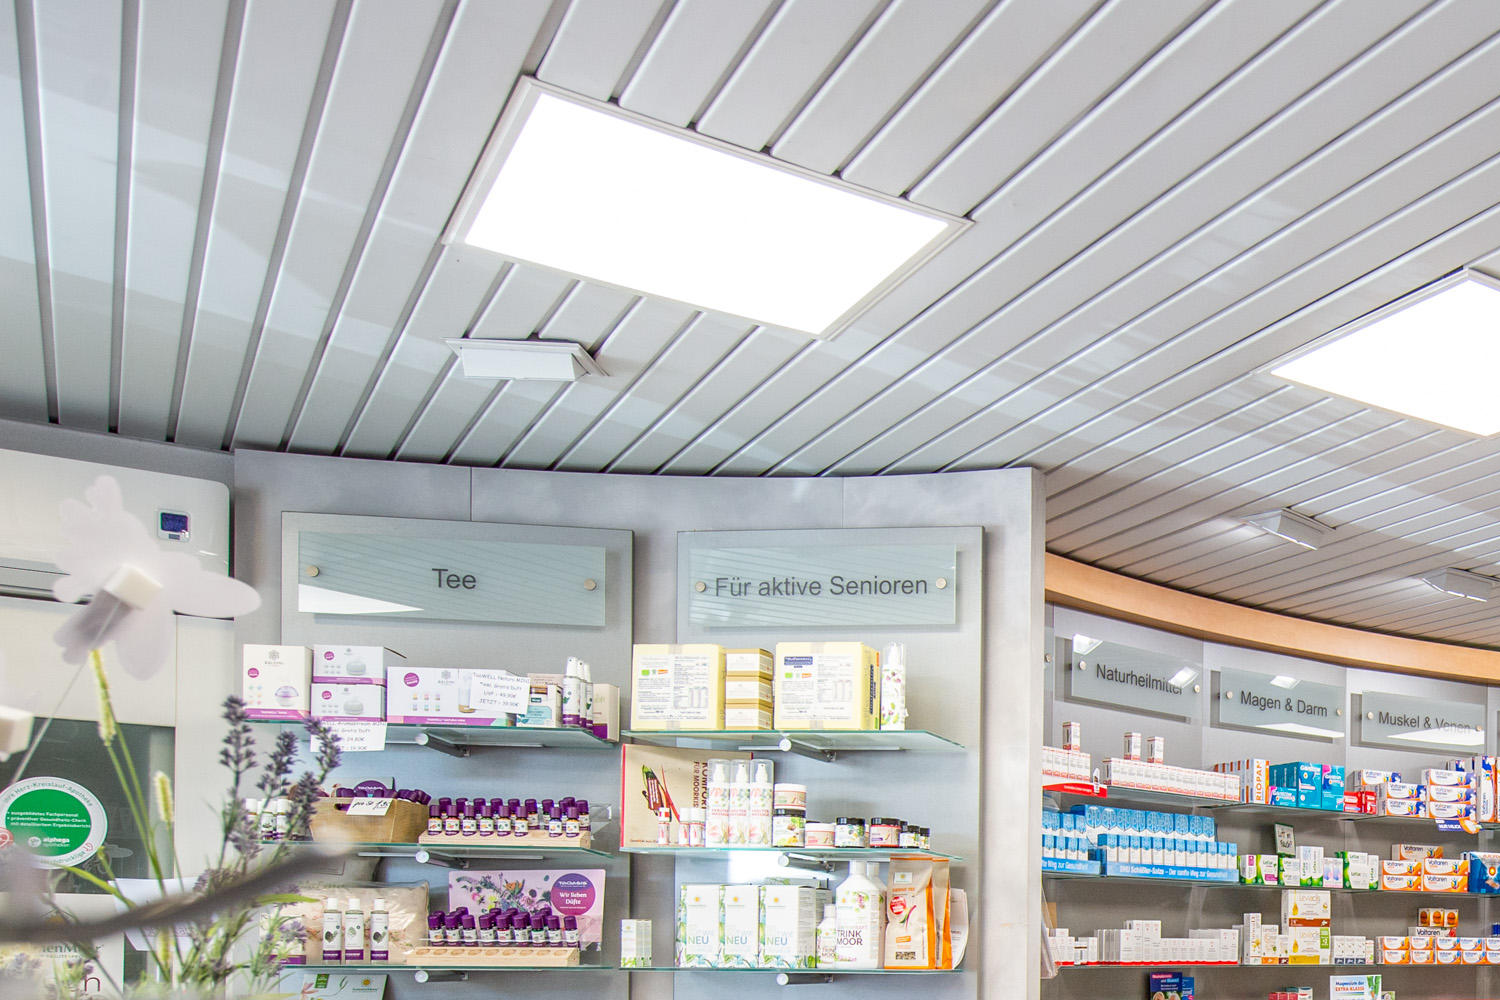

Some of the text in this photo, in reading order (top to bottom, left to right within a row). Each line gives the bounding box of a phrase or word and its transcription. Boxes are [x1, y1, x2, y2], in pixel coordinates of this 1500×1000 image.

[432, 567, 477, 589] Tee
[715, 574, 928, 597] Für aktive Senioren
[1240, 690, 1328, 717] Magen & Darm
[1378, 711, 1419, 727] Muskel
[1423, 714, 1431, 728] &
[1255, 761, 1263, 801] RIOPAN
[836, 929, 862, 938] TRINK
[1417, 928, 1440, 936] Voltaren
[688, 936, 709, 945] NEU
[726, 936, 748, 945] NEU
[766, 936, 787, 946] NEU
